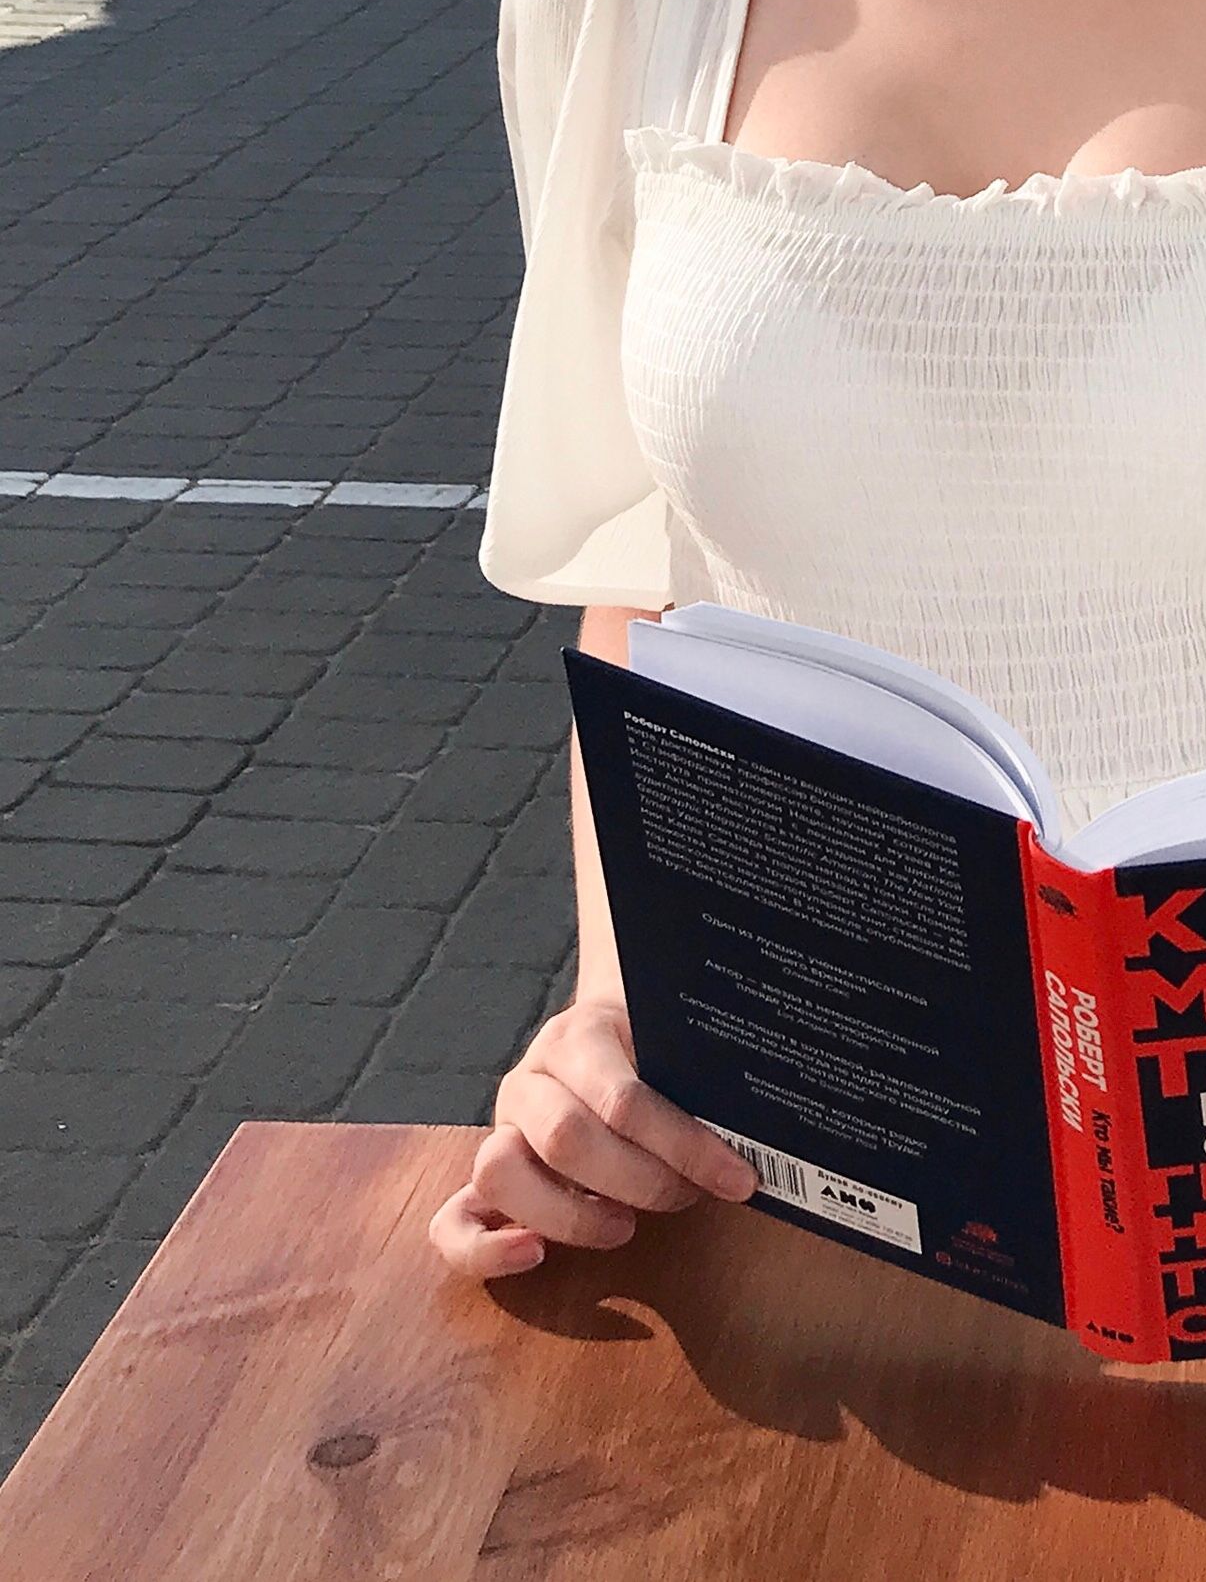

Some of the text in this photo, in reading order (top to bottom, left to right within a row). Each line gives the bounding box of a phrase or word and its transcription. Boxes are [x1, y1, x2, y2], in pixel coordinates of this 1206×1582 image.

[623, 709, 667, 736] Роберт
[669, 726, 736, 761] Сапольски
[701, 911, 736, 934] Один
[1045, 969, 1083, 1132] САПОЛЬСКИ
[1070, 986, 1107, 1092] РОБЕРТ
[1092, 1108, 1124, 1234] Кто мы такие?
